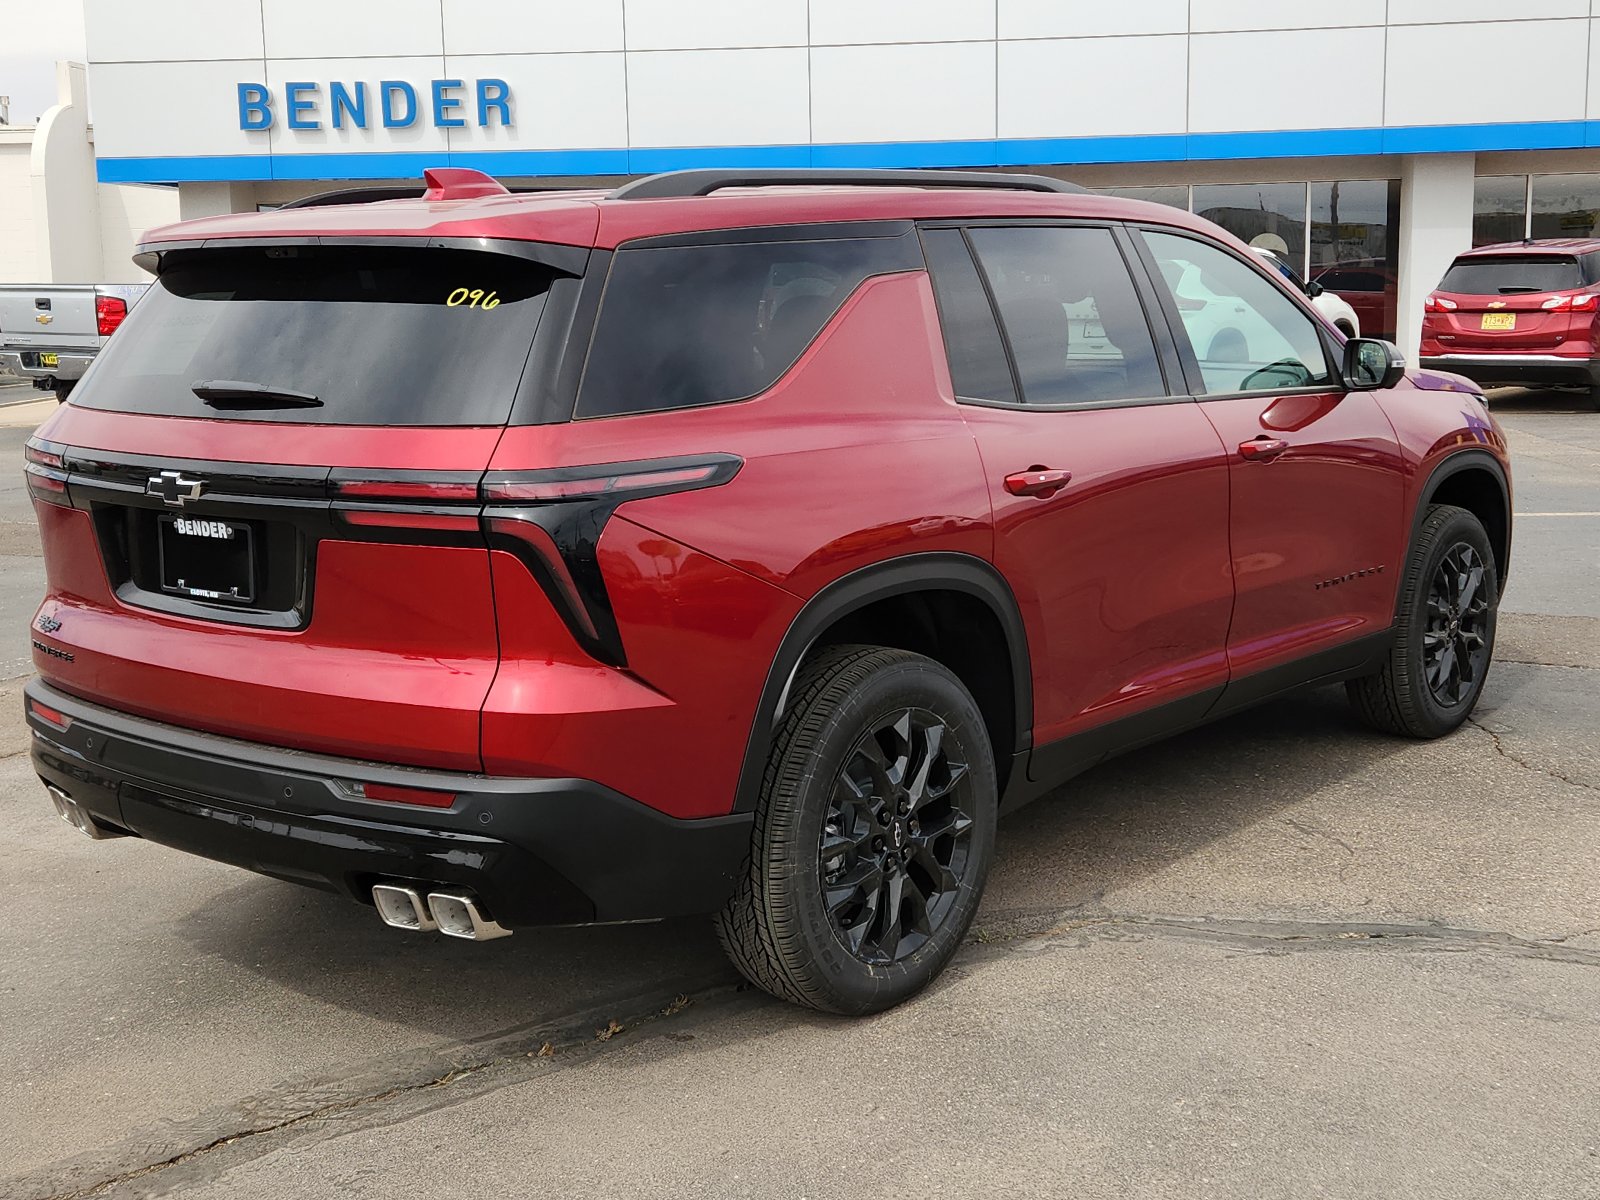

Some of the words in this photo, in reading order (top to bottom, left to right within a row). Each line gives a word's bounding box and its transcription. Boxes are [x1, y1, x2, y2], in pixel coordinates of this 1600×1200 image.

[237, 78, 514, 131] BENDER
[446, 288, 501, 310] 096
[176, 518, 228, 539] BENDER
